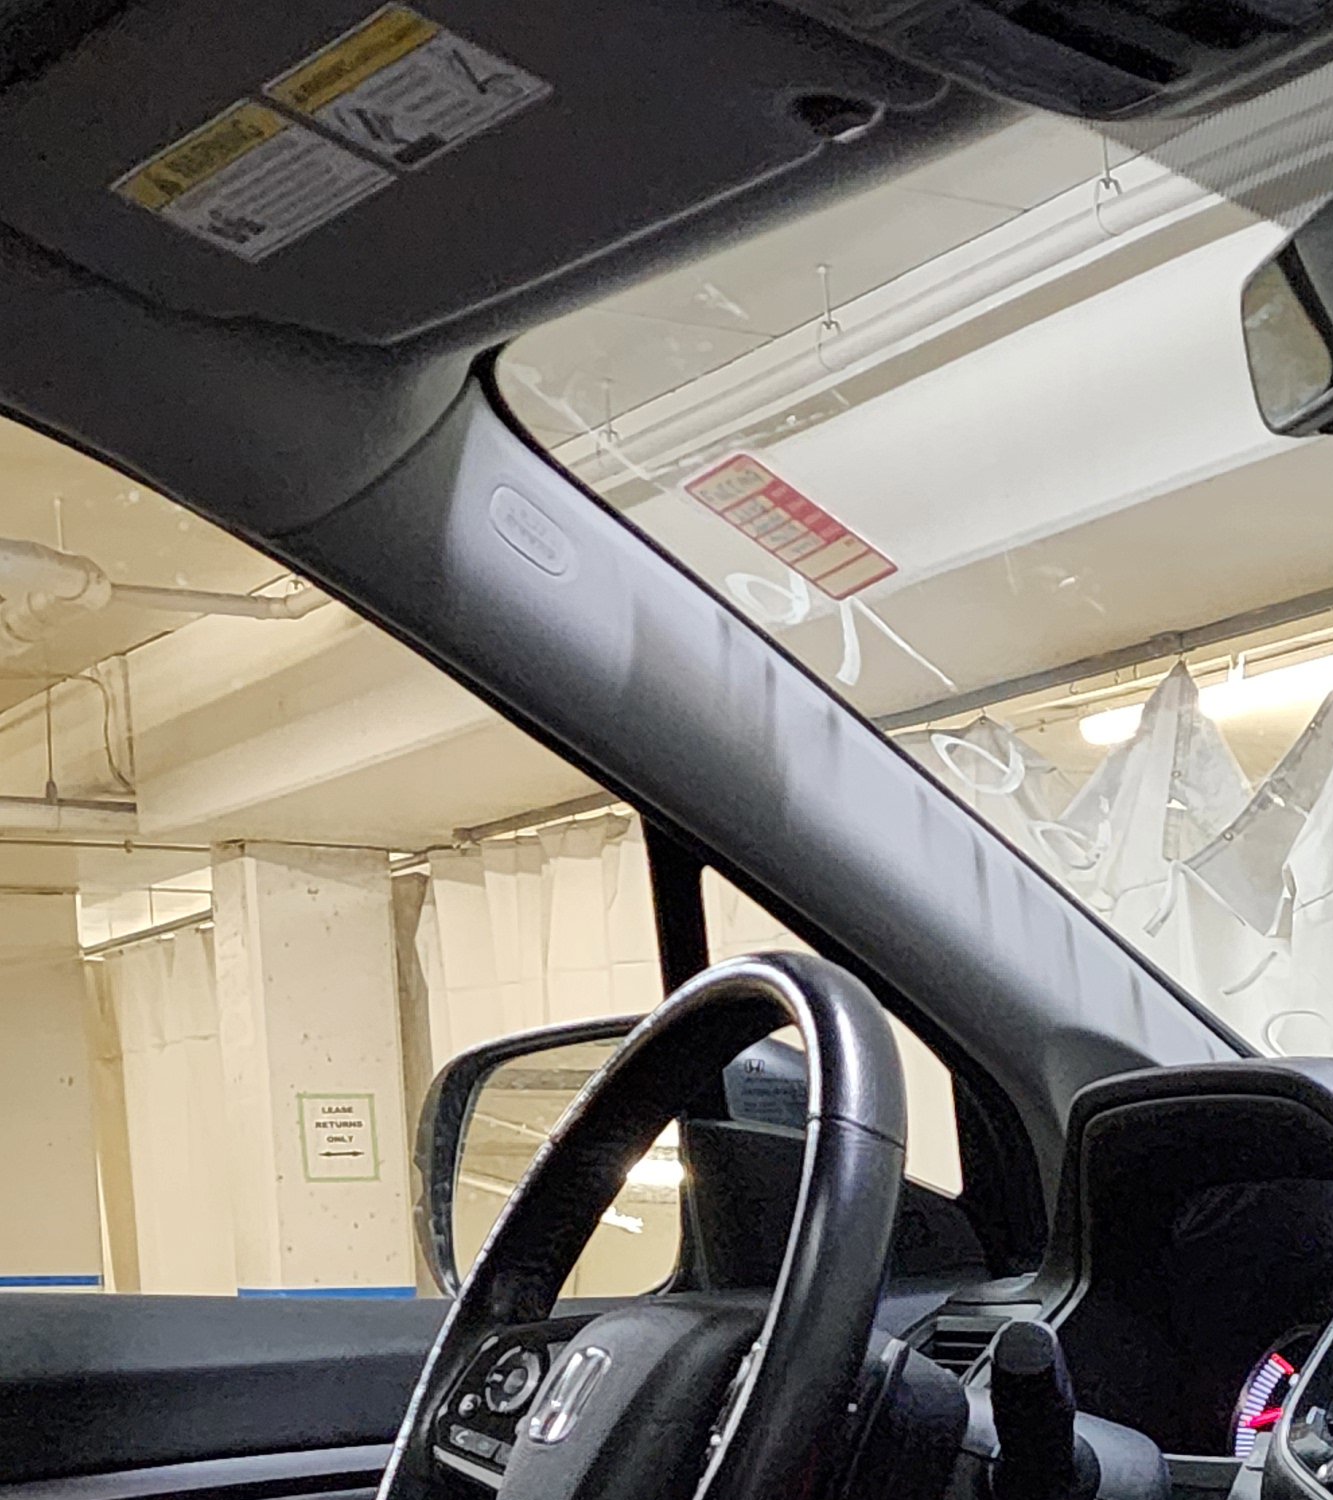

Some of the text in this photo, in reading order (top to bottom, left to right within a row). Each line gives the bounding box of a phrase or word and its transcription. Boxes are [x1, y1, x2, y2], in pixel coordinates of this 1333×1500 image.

[321, 1106, 353, 1114] LEASE
[315, 1120, 363, 1128] RETURNS
[326, 1135, 353, 1143] ONLY
